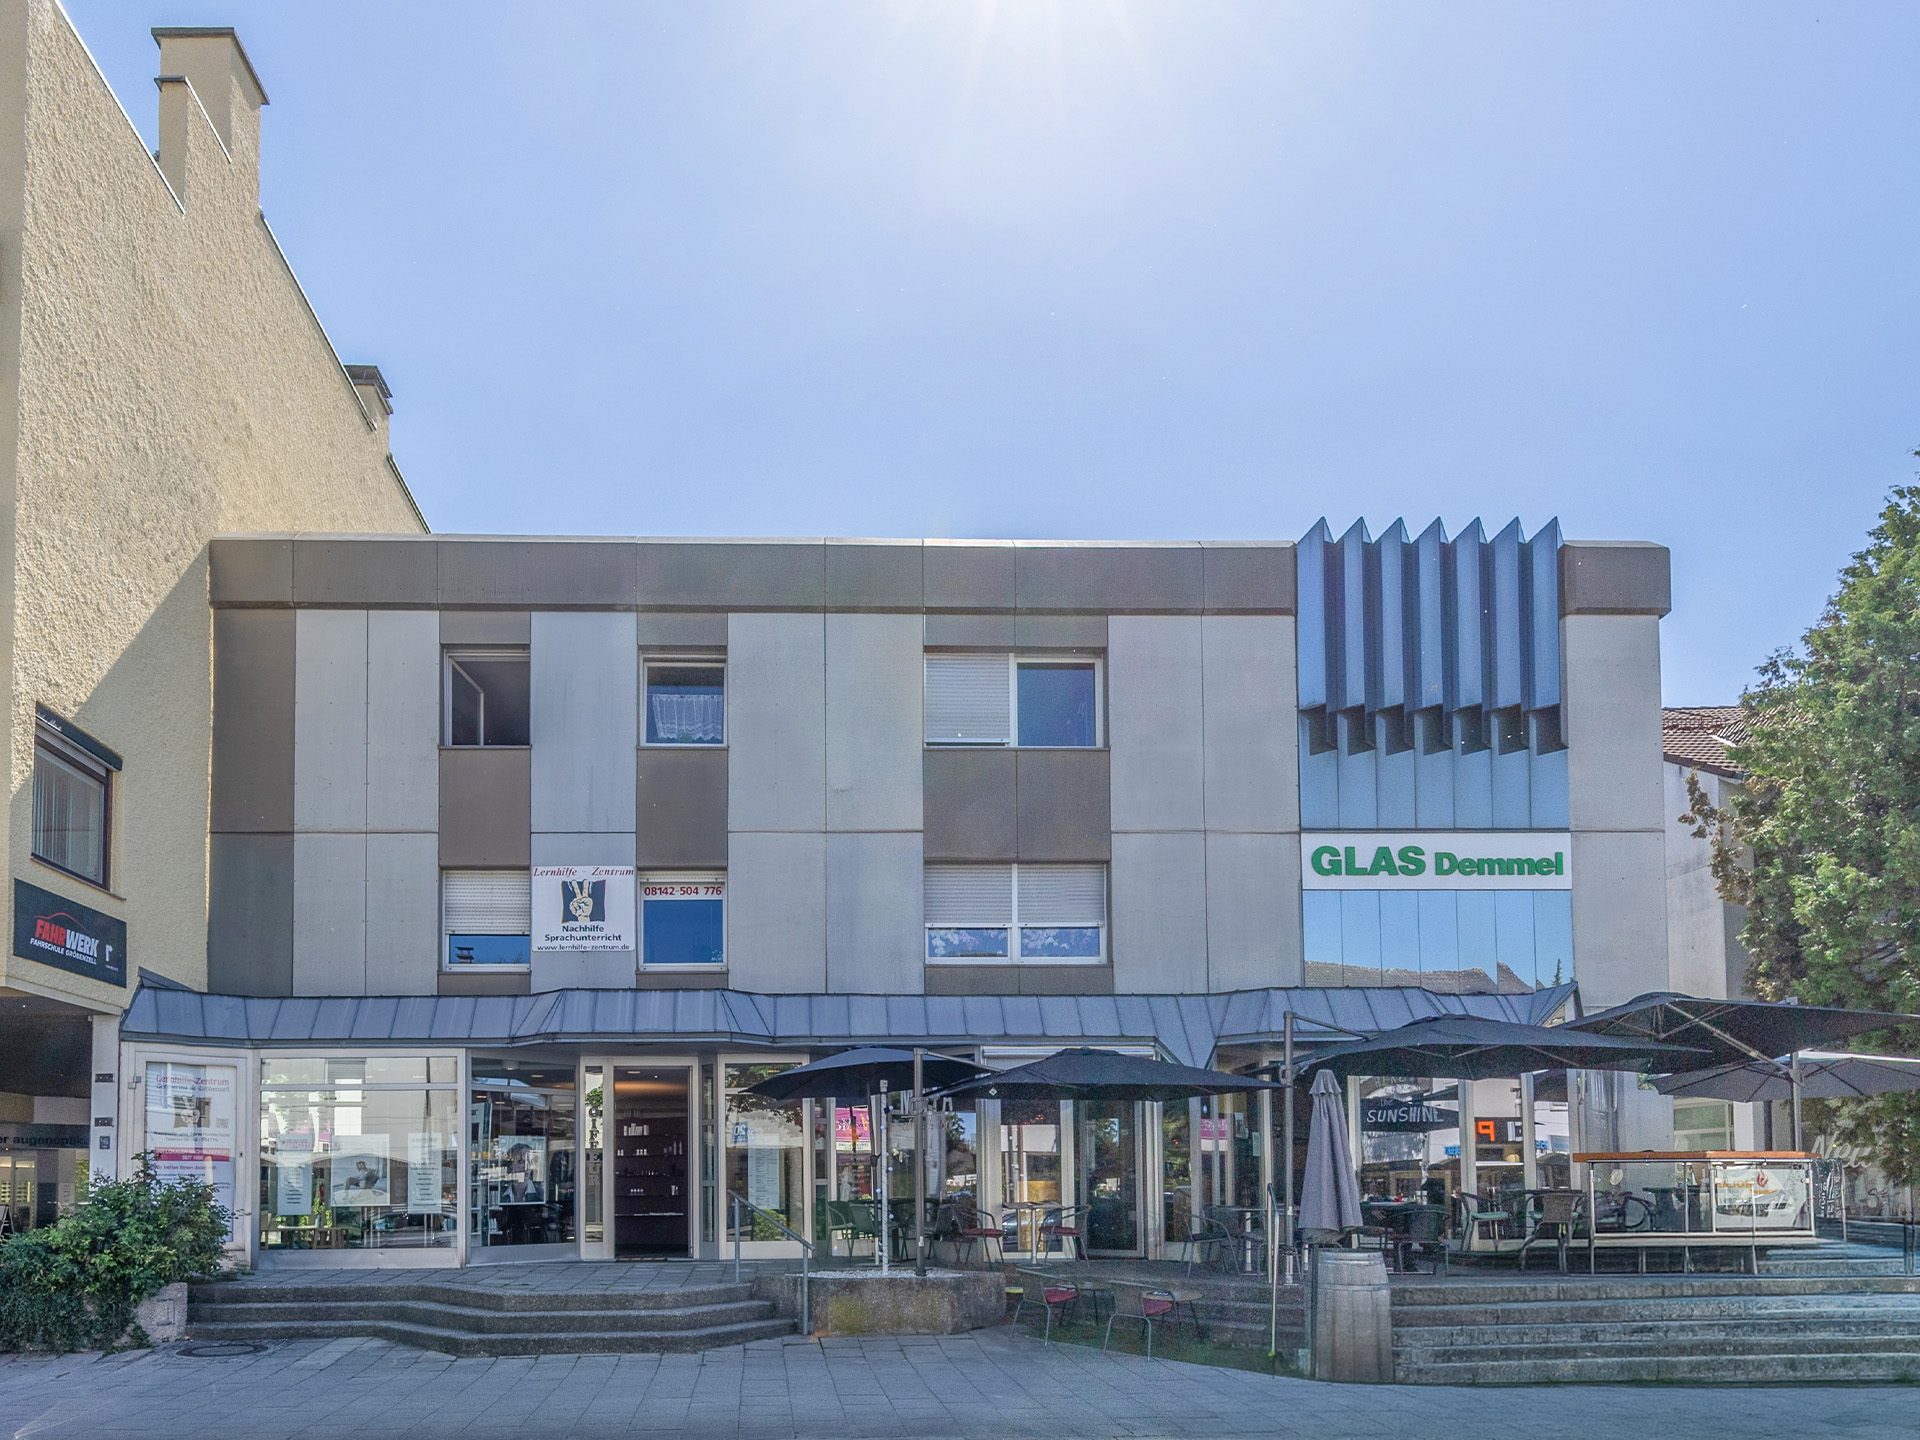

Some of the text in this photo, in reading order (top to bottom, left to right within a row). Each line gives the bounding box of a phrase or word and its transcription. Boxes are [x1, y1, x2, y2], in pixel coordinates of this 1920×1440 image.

[1311, 845, 1564, 876] GLAS Demmel
[533, 867, 578, 878] Lernhilfe
[591, 866, 634, 876] Zentrum
[644, 886, 722, 896] 08142-504 776
[562, 924, 605, 933] Nachhilfe
[34, 918, 100, 958] FAHRWERK
[544, 934, 622, 943] Sprachunterricht
[29, 937, 97, 965] FAHRSCHULE GRÖBENZELL
[537, 943, 630, 951] www.lernhilfe-zentrum.de
[1366, 1107, 1445, 1123] SUNSHINE
